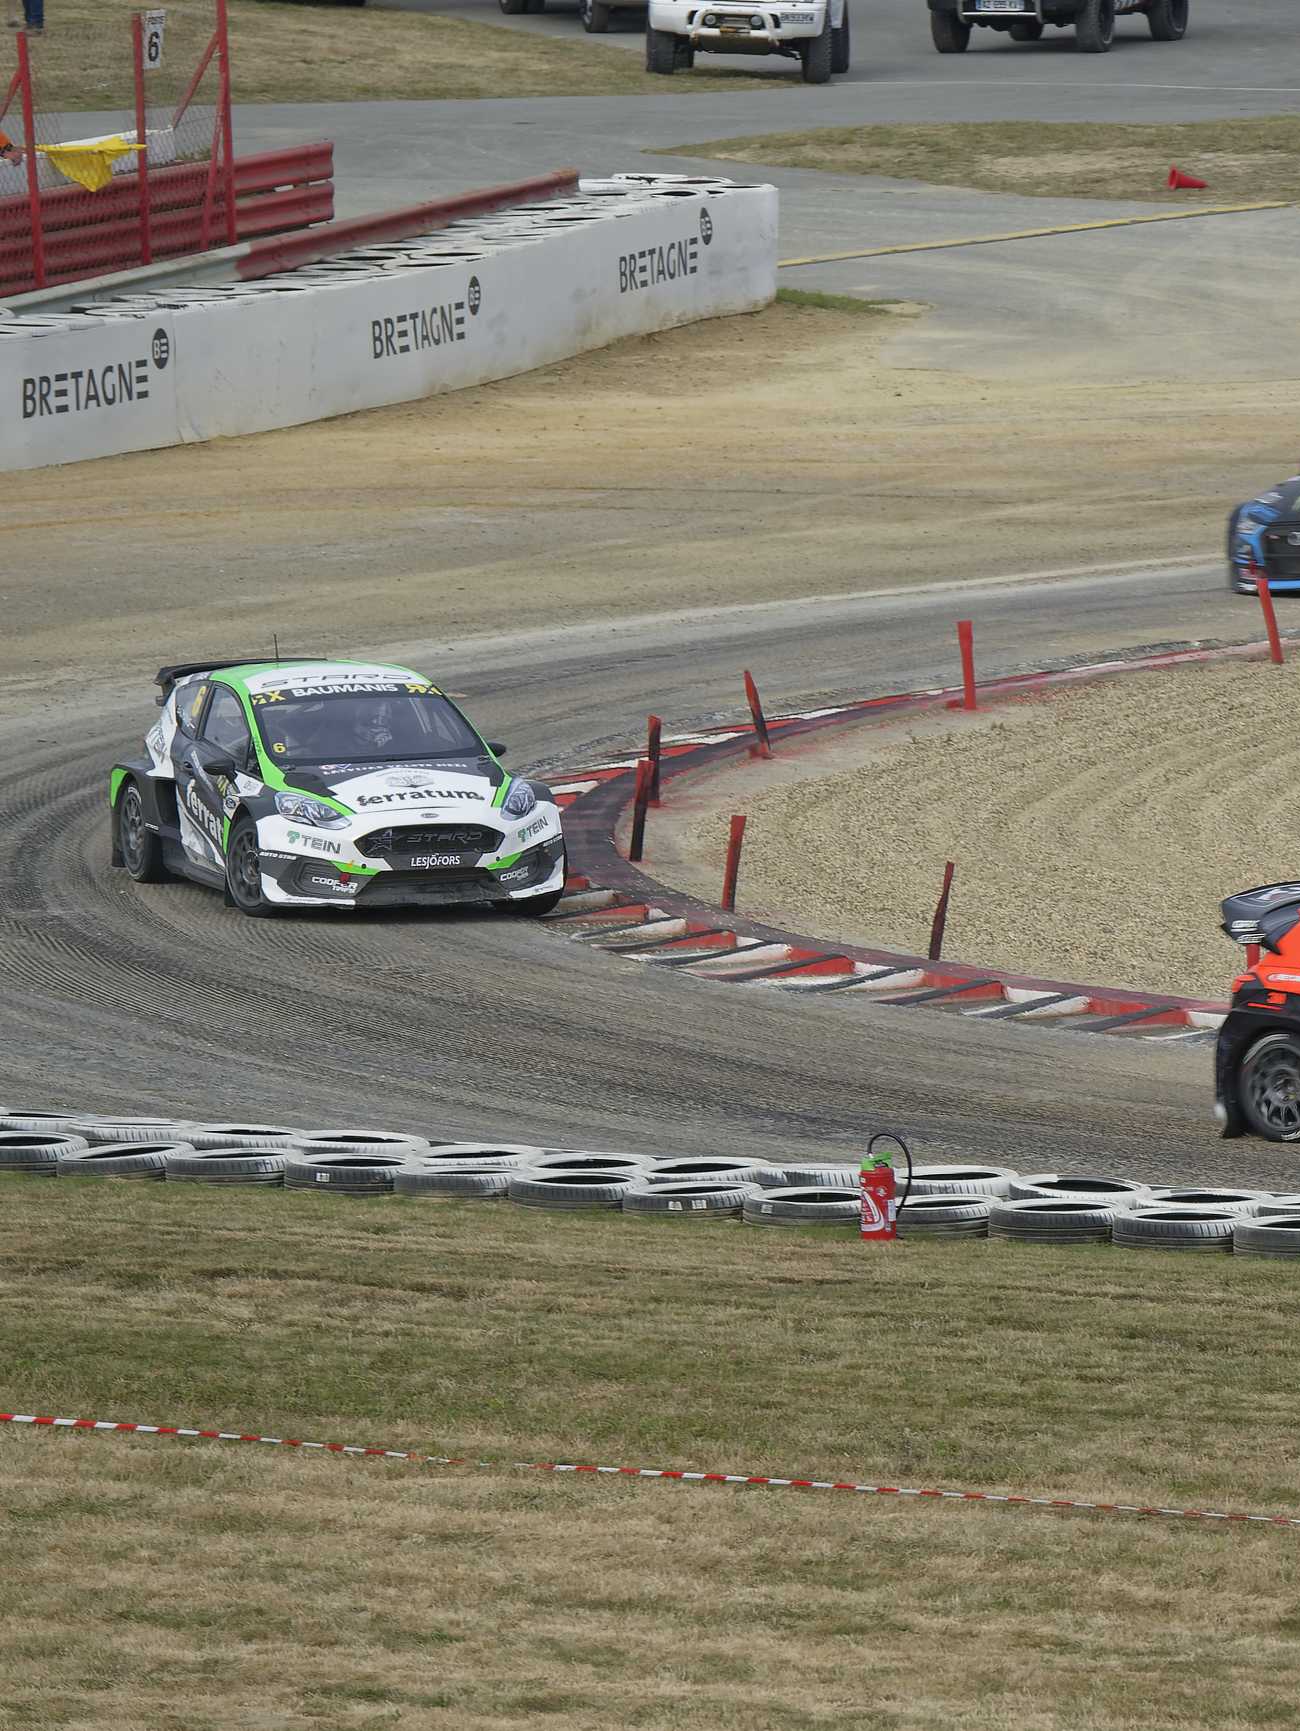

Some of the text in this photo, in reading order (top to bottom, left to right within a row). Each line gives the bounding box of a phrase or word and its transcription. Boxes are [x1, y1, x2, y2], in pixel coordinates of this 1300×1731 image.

[148, 31, 159, 61] 6
[619, 237, 698, 293] BRETAGNE
[372, 301, 465, 359] BRETAGNE
[22, 359, 149, 419] BRETAGNE
[291, 683, 399, 698] BAUMANIS
[273, 742, 286, 754] 6
[356, 788, 486, 807] ferratum
[527, 815, 550, 840] TEIN
[301, 833, 341, 855] TEIN
[411, 852, 462, 870] LESJÖFORS
